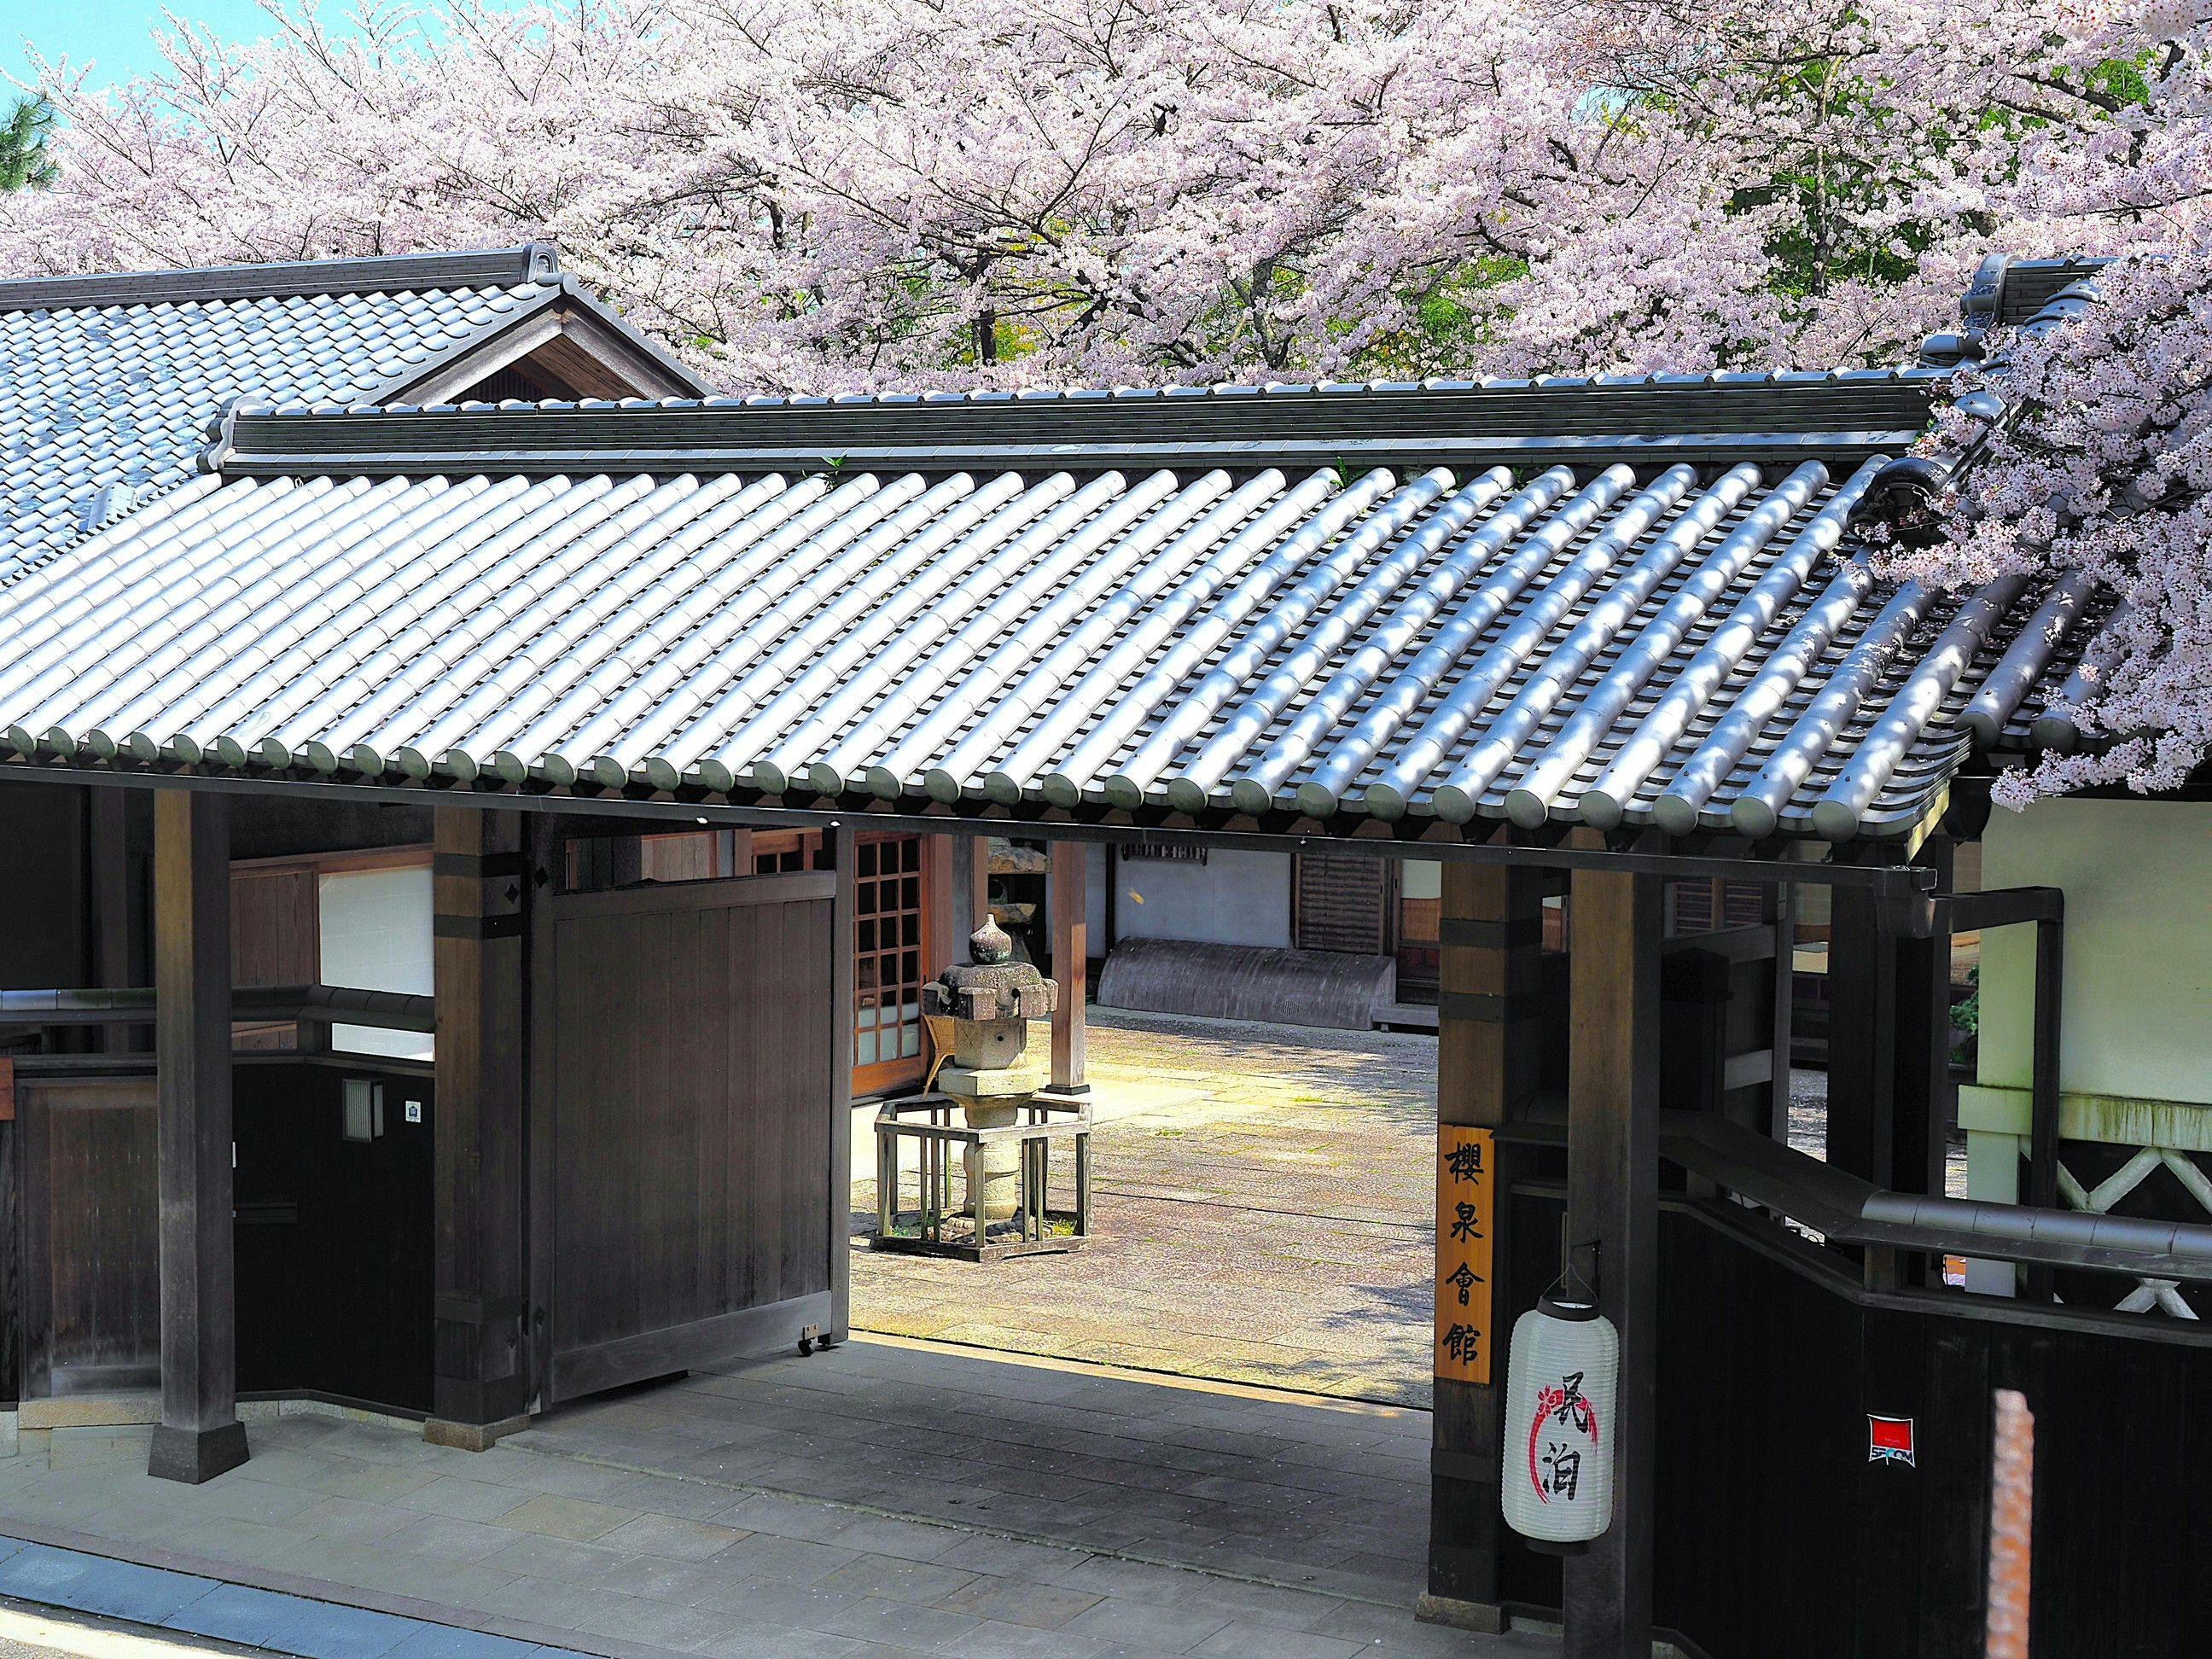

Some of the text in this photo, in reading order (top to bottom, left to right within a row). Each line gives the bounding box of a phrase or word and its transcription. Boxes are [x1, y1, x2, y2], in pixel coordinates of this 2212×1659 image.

[1442, 1142, 1485, 1365] 櫻泉會館
[1543, 1371, 1589, 1501] 民泊
[1871, 1447, 1912, 1462] SECOM
